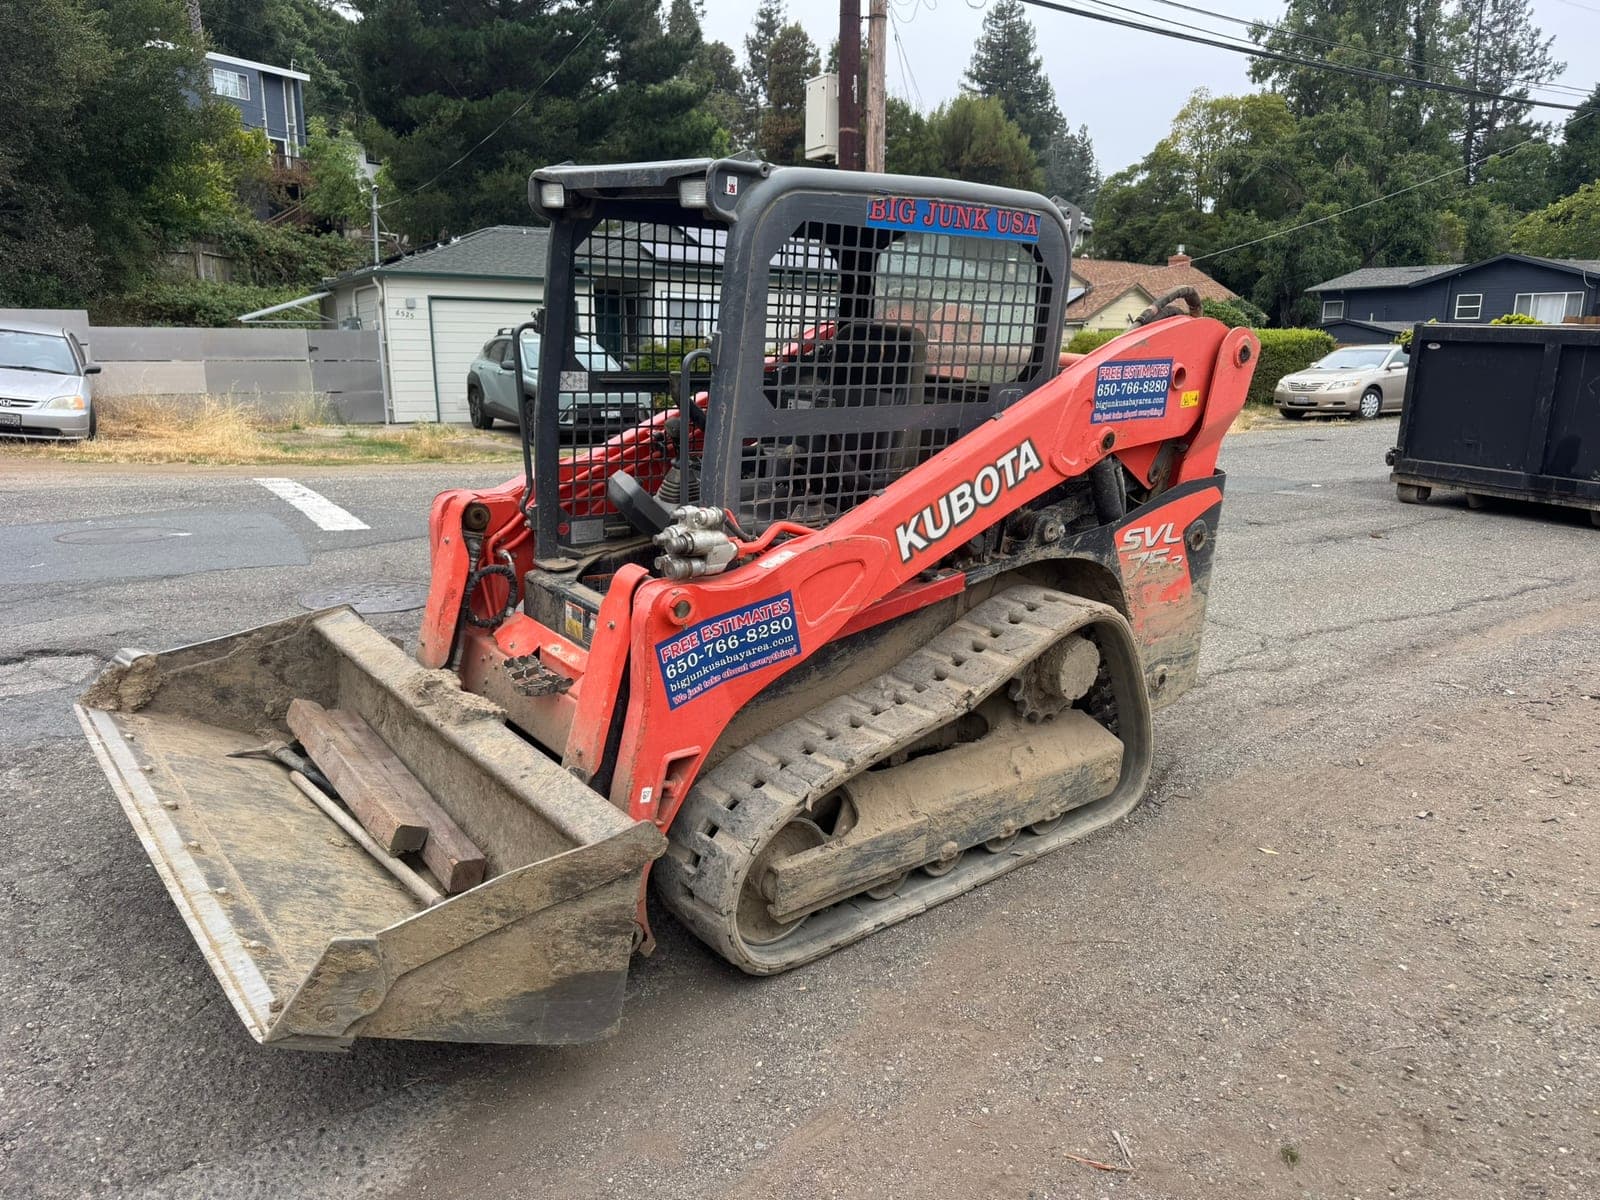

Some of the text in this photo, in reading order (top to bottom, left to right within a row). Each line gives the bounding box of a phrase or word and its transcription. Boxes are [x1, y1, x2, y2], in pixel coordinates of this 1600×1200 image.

[869, 197, 1039, 235] BIG JUNK USA
[1097, 380, 1167, 397] 650-766-8280
[1098, 364, 1170, 380] FREE ESTIMATES
[895, 439, 1042, 562] KUBOTA
[1119, 522, 1181, 552] SVL
[660, 598, 791, 663] FREE ESTIMATES
[666, 616, 793, 679] 650-766-8280
[670, 634, 794, 692] bigjunkusabayarea.com
[672, 644, 798, 704] We just take about everything!
